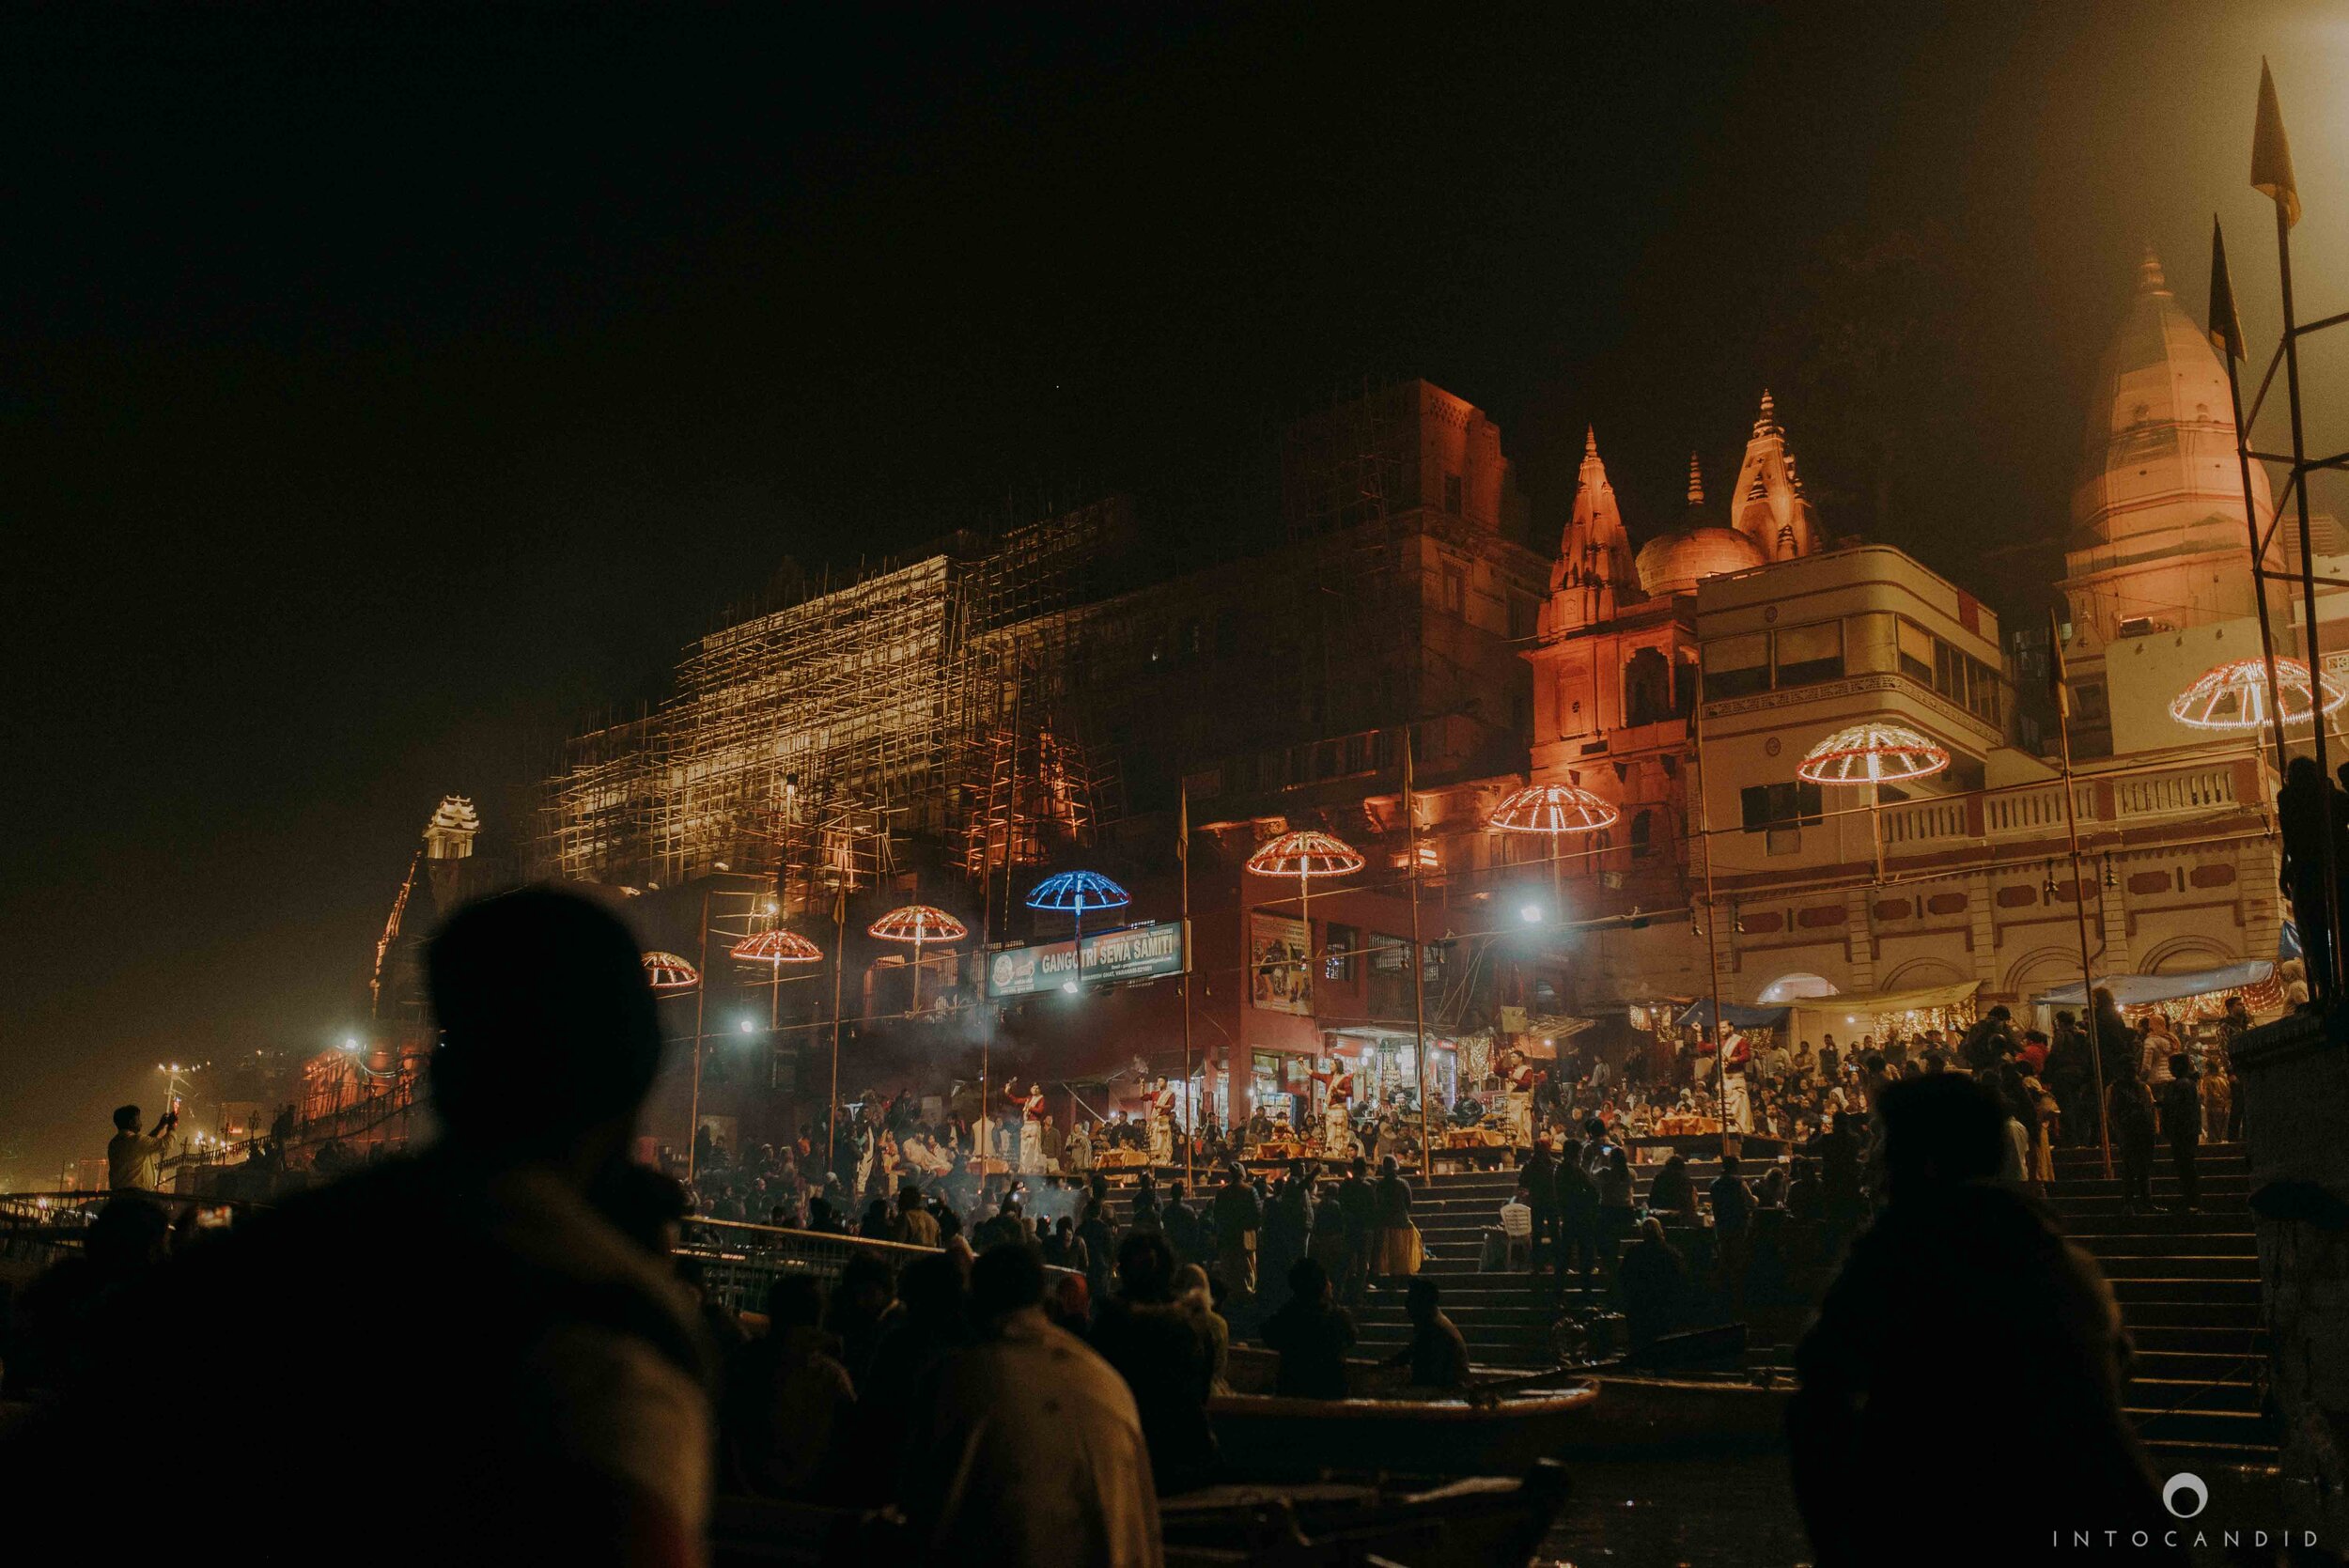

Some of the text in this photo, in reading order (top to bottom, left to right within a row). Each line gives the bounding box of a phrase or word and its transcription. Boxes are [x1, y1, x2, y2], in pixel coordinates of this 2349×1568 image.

[1042, 948, 1097, 973] GANGOTRI
[1099, 941, 1131, 965] SEWA
[1133, 934, 1173, 960] SAMITI
